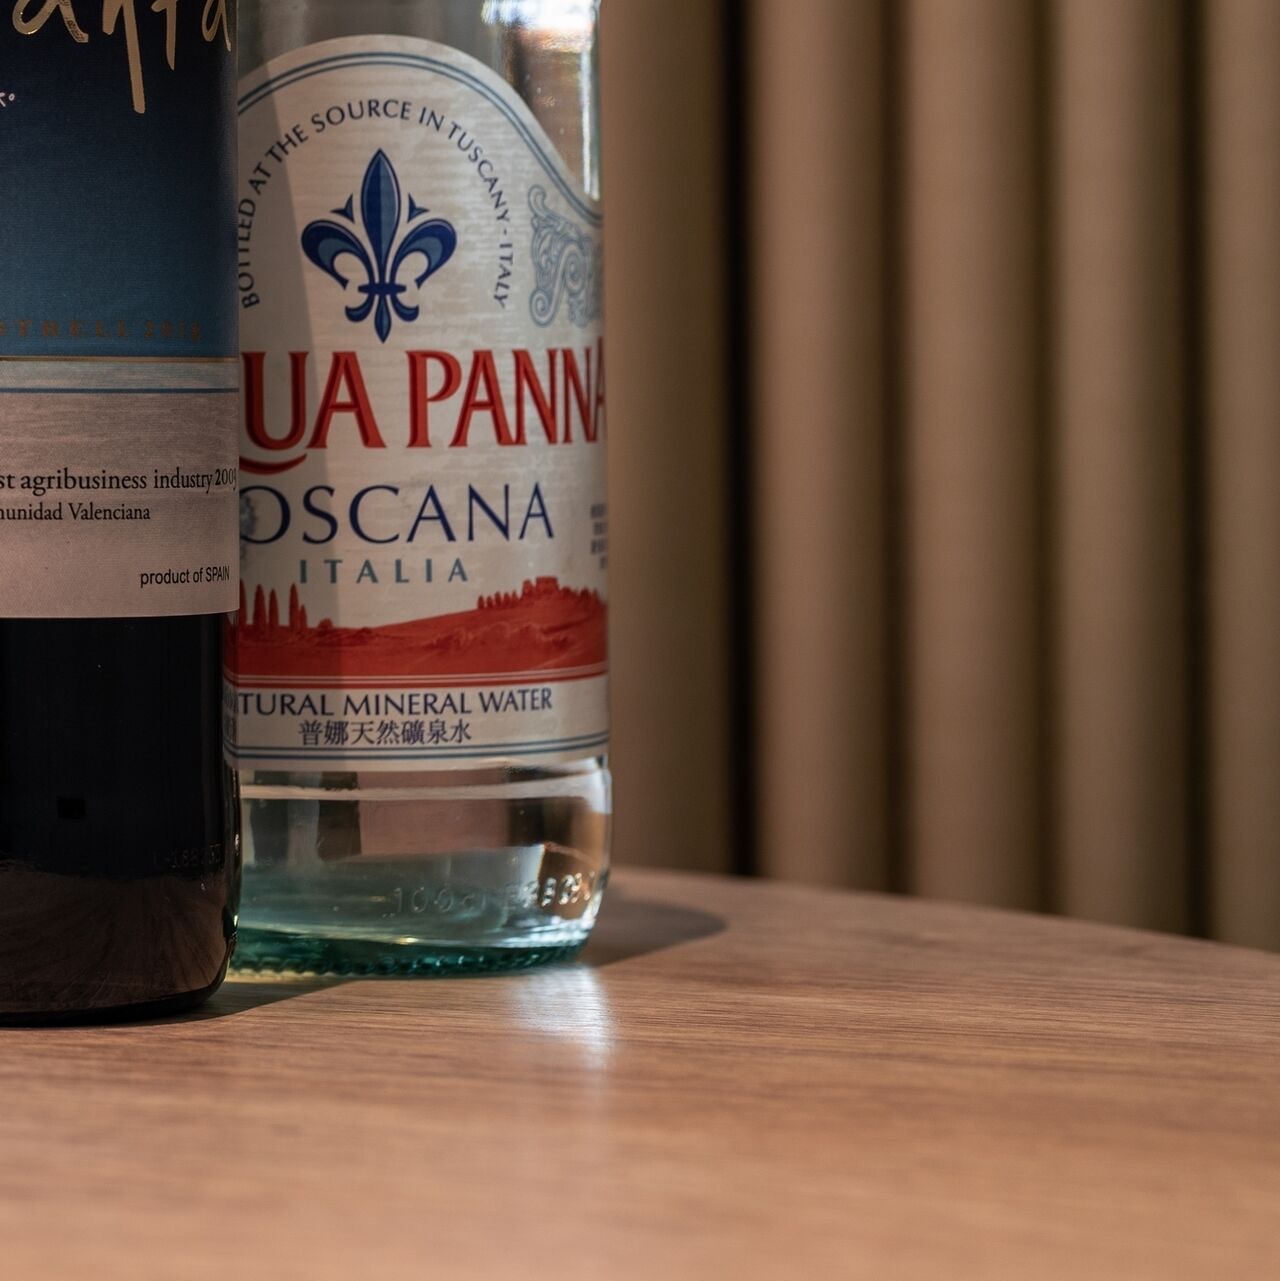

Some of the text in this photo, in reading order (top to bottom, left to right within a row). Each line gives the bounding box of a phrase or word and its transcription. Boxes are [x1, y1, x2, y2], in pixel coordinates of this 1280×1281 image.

[248, 162, 272, 195] AT
[265, 124, 309, 163] THE
[311, 99, 412, 133] SOURCE
[419, 107, 445, 131] IN
[448, 121, 510, 221] TUSCANY
[494, 242, 514, 308] ITALY
[238, 351, 387, 475] UA
[20, 466, 148, 497] agribusiness
[153, 466, 213, 495] industry
[67, 501, 151, 521] Valenciana
[239, 482, 554, 544] OSCANA
[140, 565, 230, 589] product of SPAIN
[299, 558, 469, 584] ITALIA
[238, 692, 335, 716] TURAL
[343, 692, 472, 716] MINERAL
[478, 687, 553, 714] WATER
[298, 719, 473, 746] 普娜天然礦泉水
